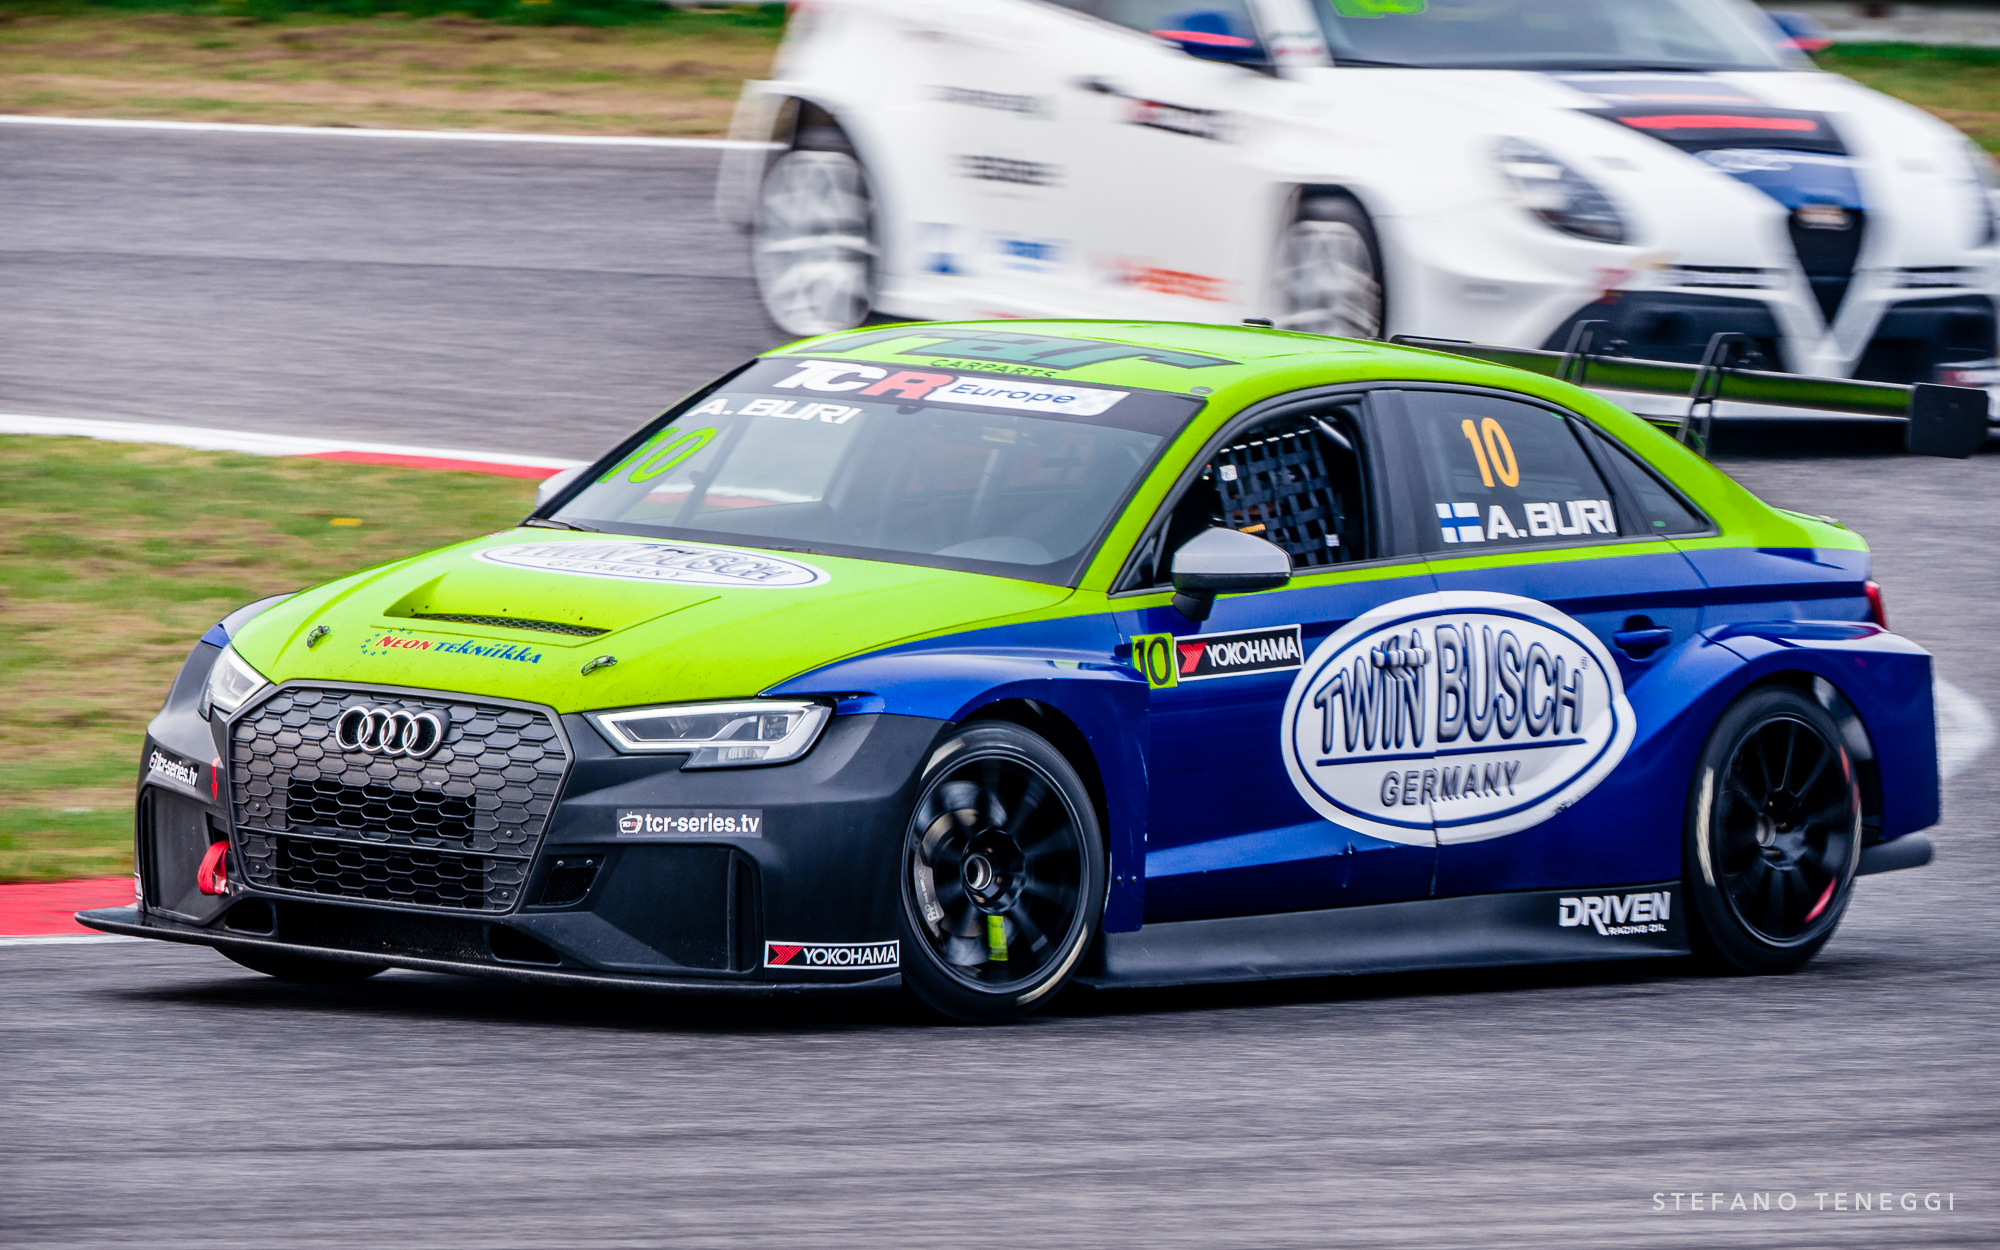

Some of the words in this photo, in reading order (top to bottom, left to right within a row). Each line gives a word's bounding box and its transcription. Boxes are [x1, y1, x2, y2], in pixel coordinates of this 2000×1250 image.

[773, 359, 956, 400] TCR
[953, 382, 1076, 404] Europe
[930, 358, 1057, 379] CARPARTS
[596, 426, 718, 483] 10
[1461, 416, 1520, 488] 10
[547, 560, 693, 578] GERMANY
[624, 547, 792, 580] BUSCH
[1134, 636, 1171, 686] 10
[1205, 635, 1300, 667] YOKOHAMA
[1314, 628, 1427, 754] TWIN
[1435, 622, 1584, 744] BUSCH
[1380, 760, 1522, 807] GERMANY
[645, 812, 760, 833] tcr-series.tv
[1559, 891, 1671, 936] DRIVEN
[1608, 924, 1648, 935] RACING
[1648, 923, 1667, 932] OIL
[803, 946, 897, 965] YOKOHAMA
